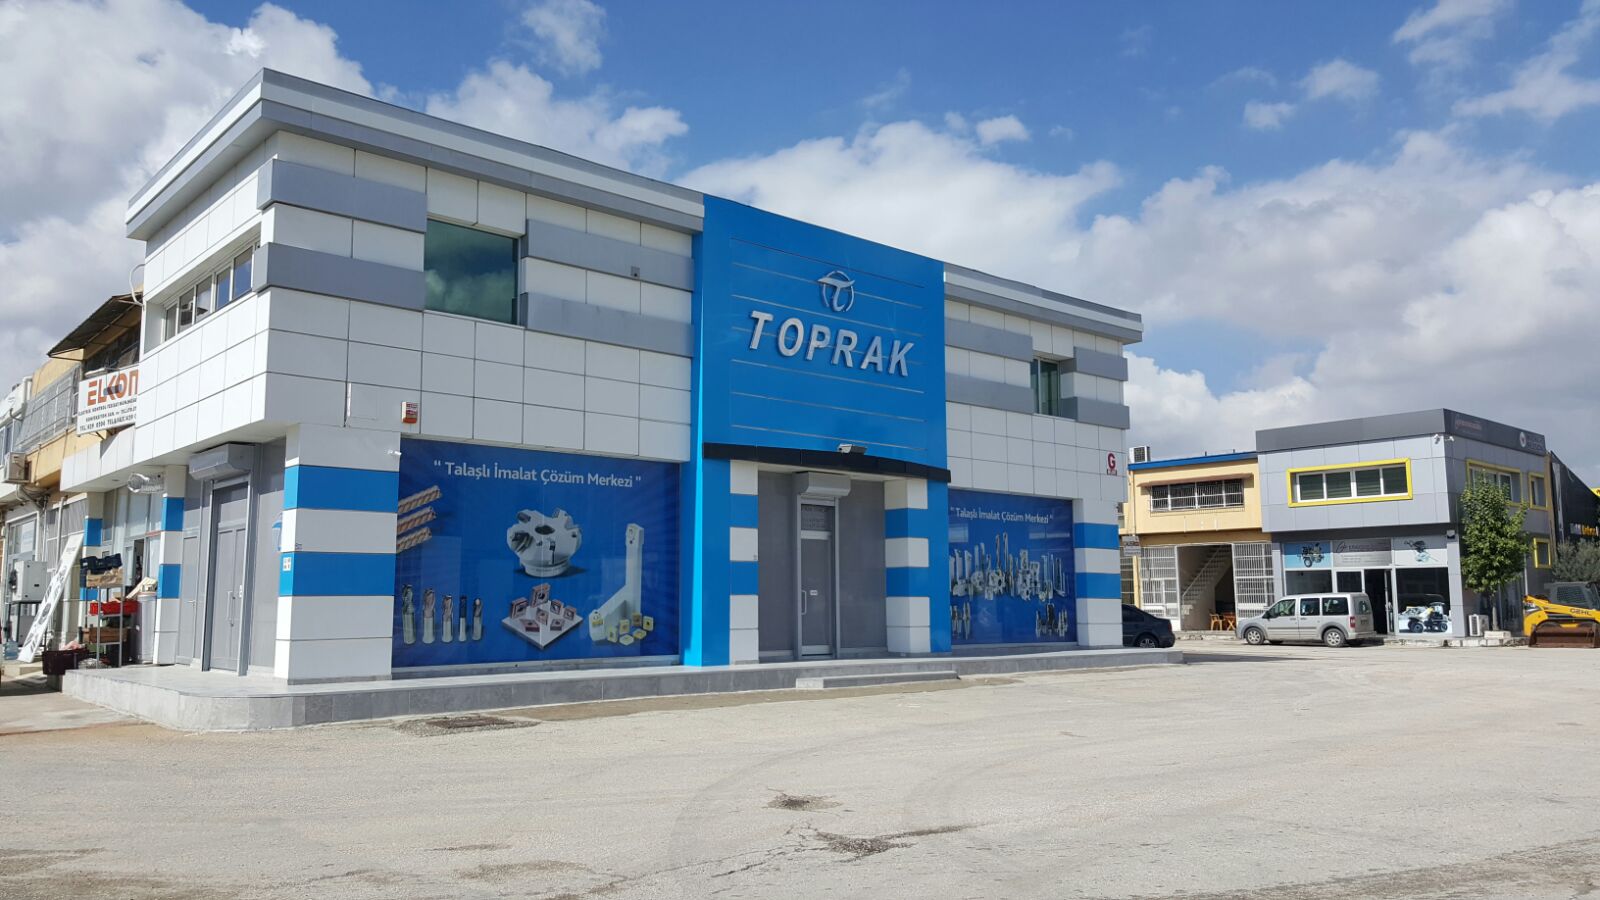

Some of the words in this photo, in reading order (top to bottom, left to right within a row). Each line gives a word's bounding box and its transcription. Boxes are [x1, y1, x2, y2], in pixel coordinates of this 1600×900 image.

[750, 310, 915, 377] TOPRAK
[445, 462, 490, 478] Talaşlı
[494, 462, 537, 481] İmalat
[540, 469, 584, 485] Çözüm
[587, 473, 633, 488] Merkezi
